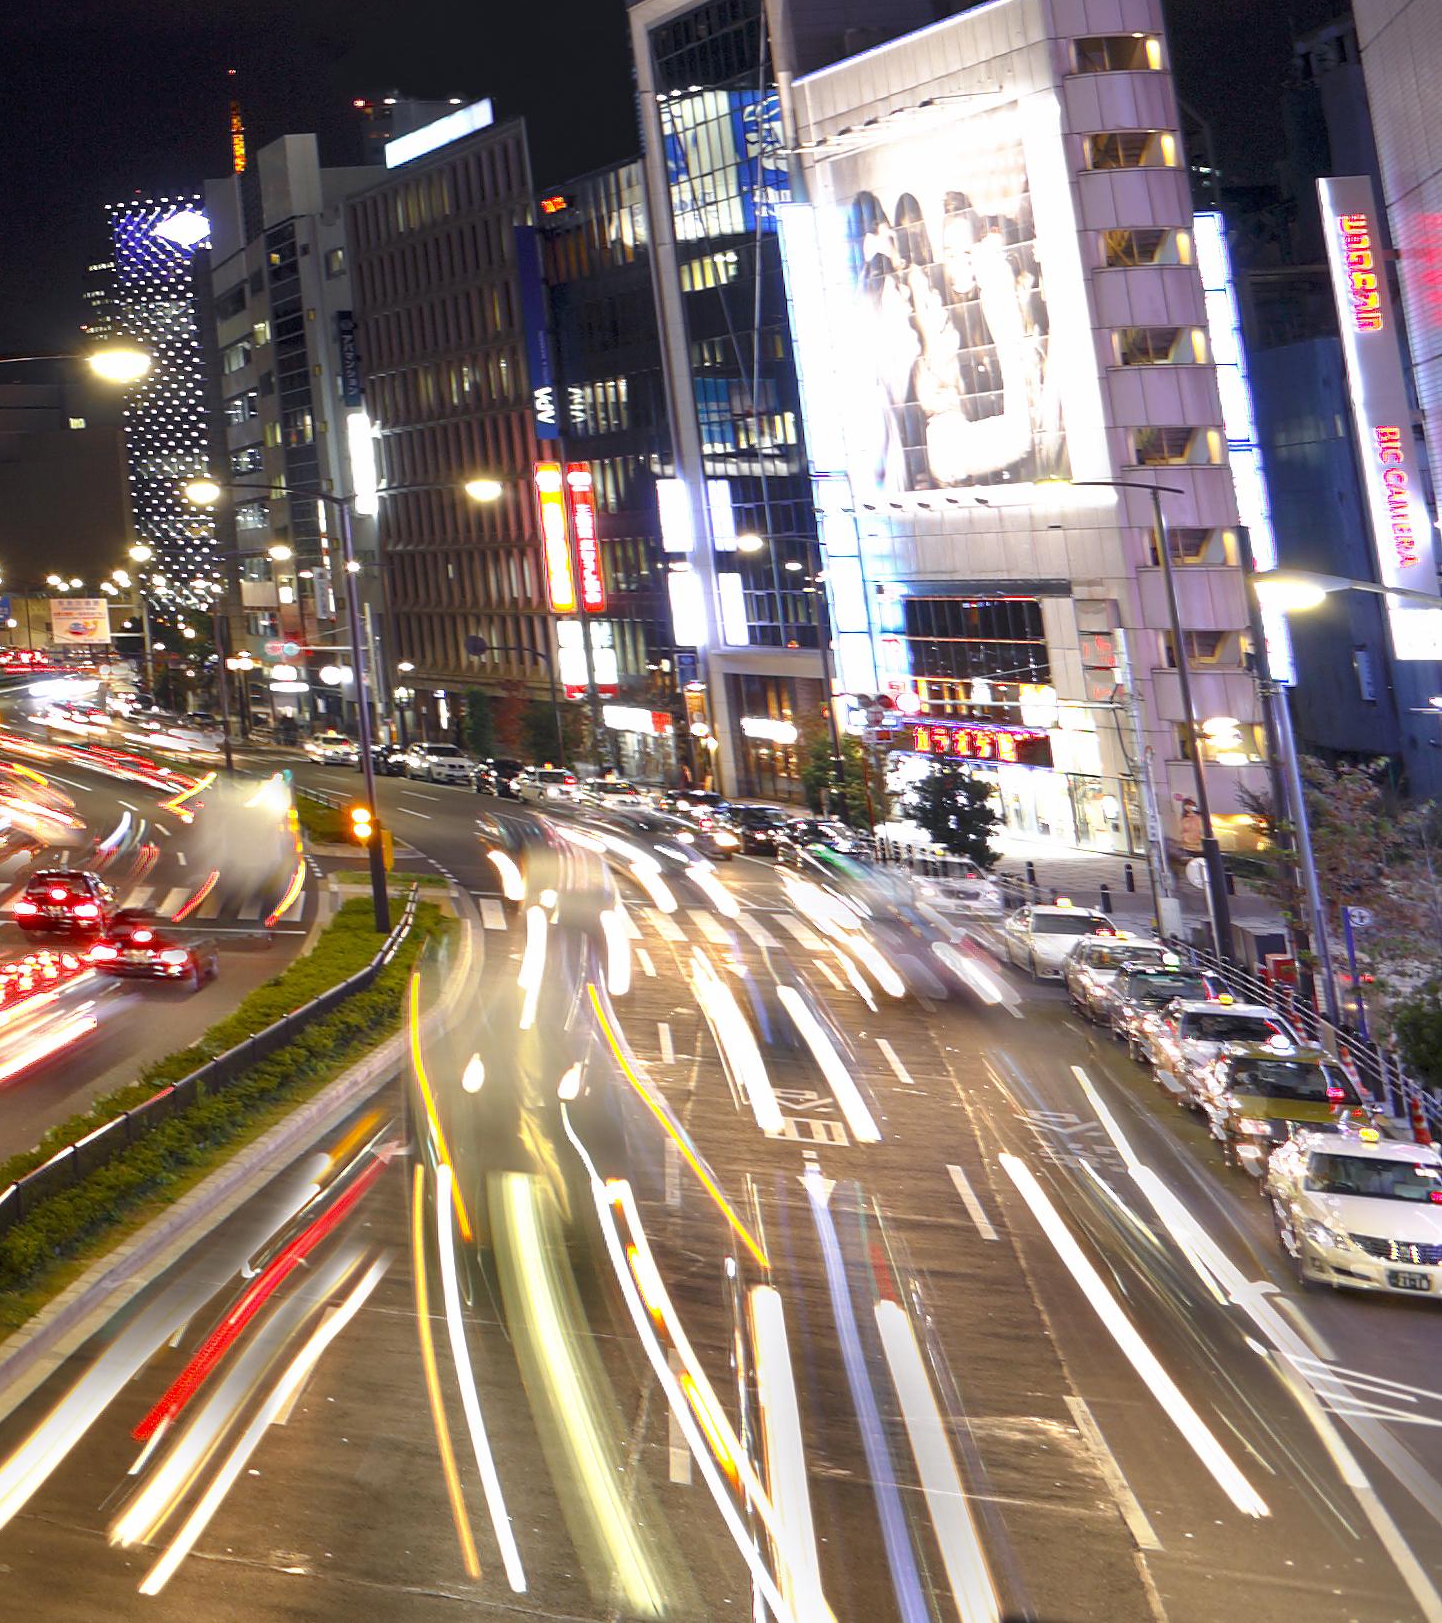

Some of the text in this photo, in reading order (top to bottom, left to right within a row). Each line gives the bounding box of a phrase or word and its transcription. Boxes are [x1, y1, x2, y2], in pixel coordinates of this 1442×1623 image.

[534, 386, 555, 424] APA
[1375, 425, 1421, 569] BIC CAMERA
